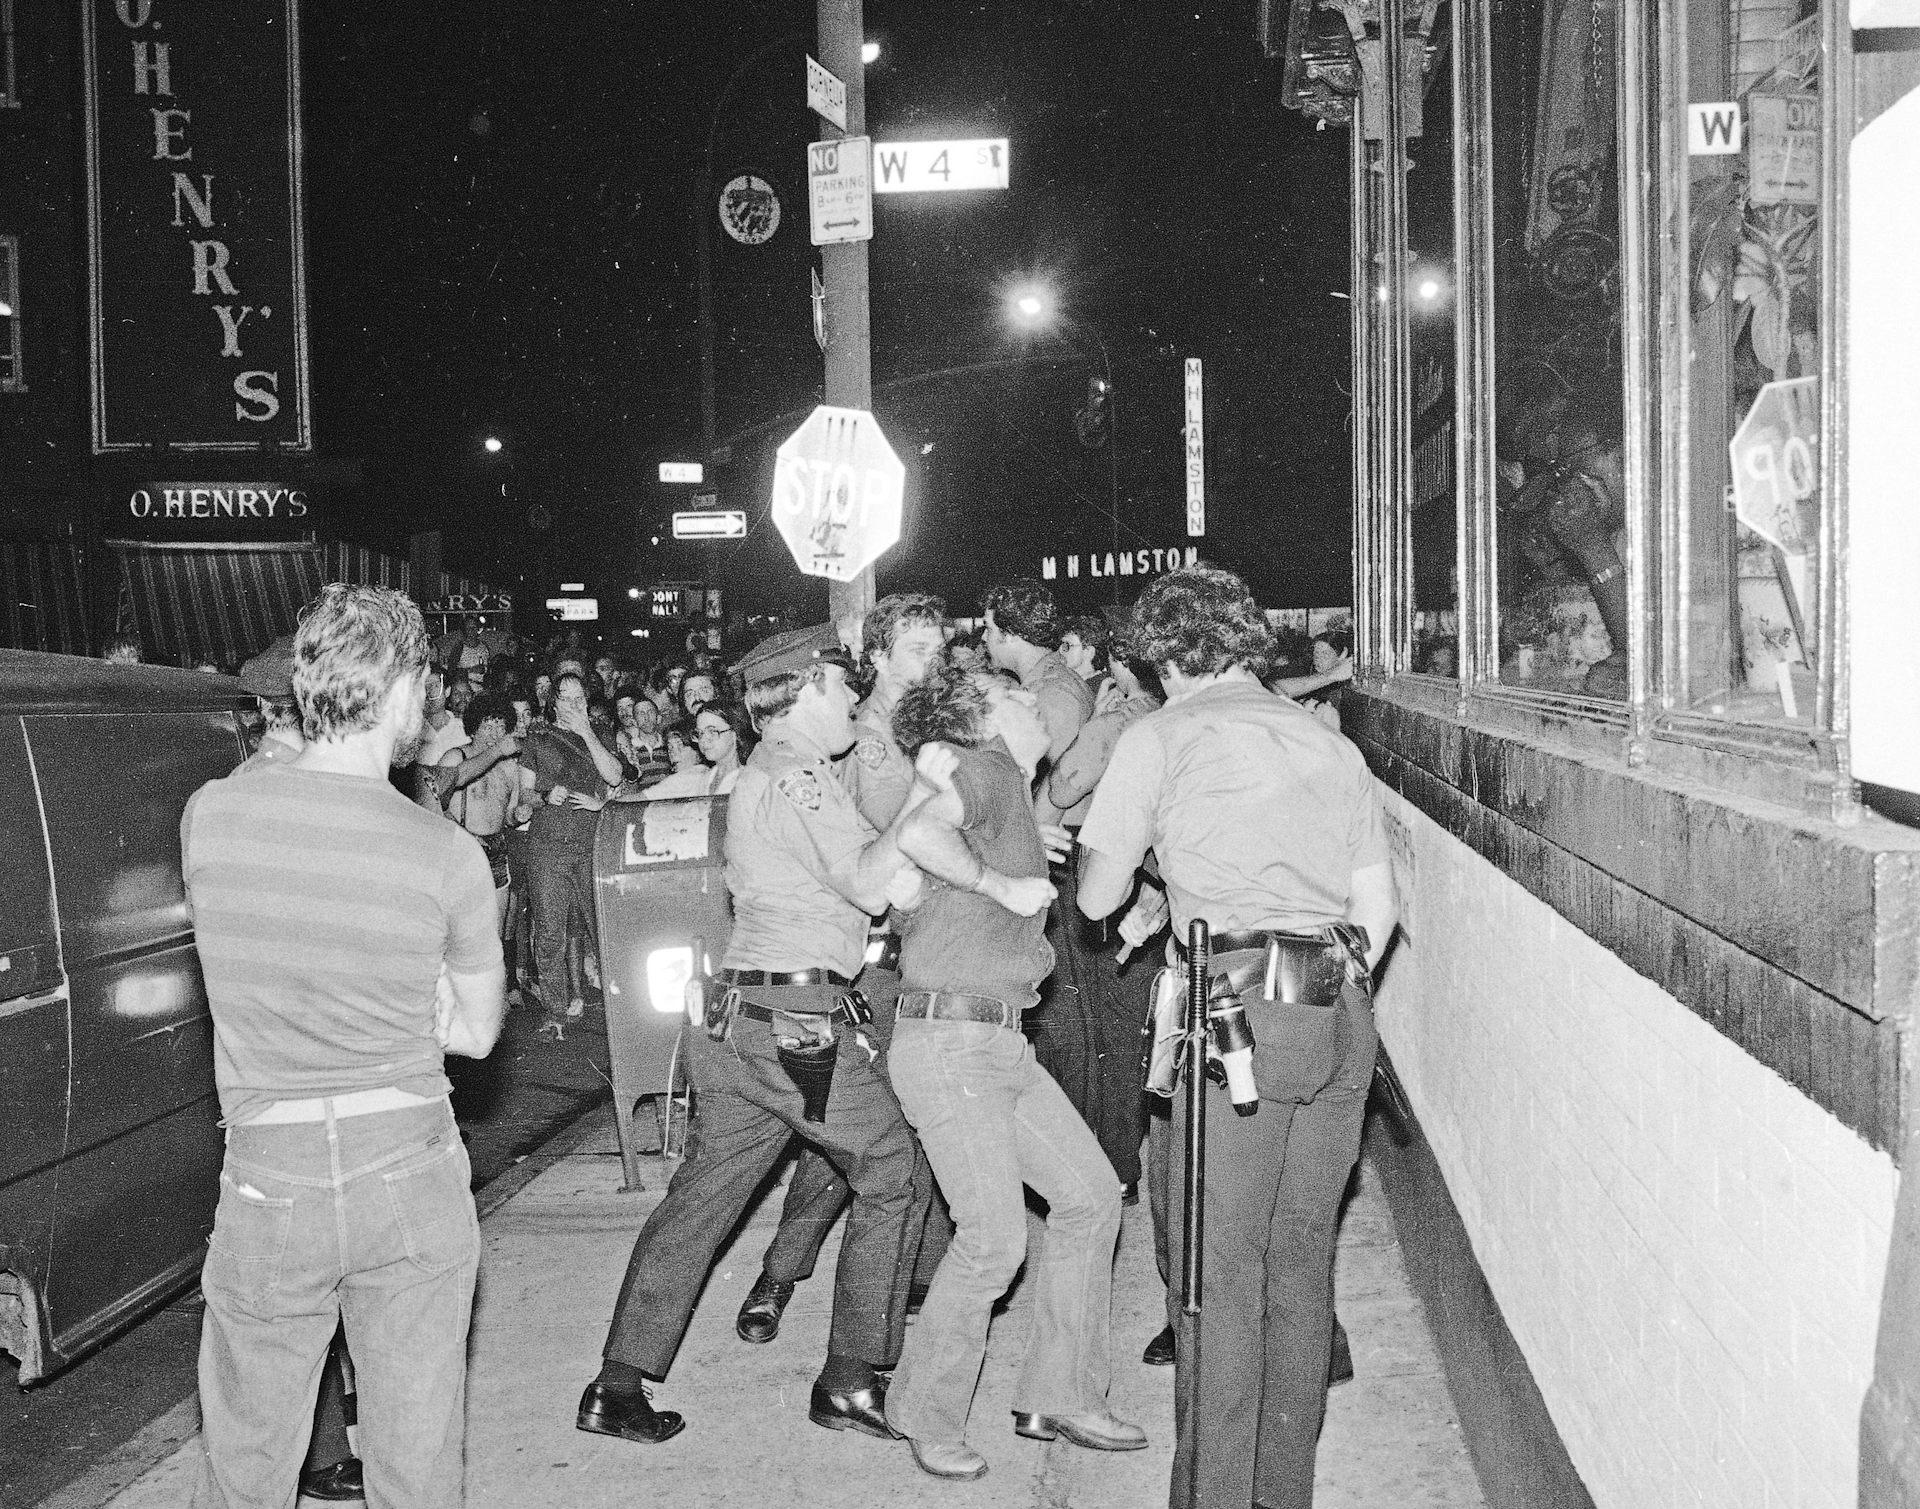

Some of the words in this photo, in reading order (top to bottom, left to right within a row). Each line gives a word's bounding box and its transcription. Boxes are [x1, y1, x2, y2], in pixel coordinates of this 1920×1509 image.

[811, 148, 838, 172] NO
[880, 150, 907, 184] W
[928, 149, 951, 182] 4
[815, 176, 865, 192] PARKING
[1187, 363, 1200, 376] M
[1188, 386, 1199, 400] H
[1188, 410, 1203, 531] LAMSTON
[784, 455, 891, 528] STOP
[1042, 556, 1057, 580] M
[1067, 554, 1080, 578] H
[1090, 546, 1198, 578] LAMSTON
